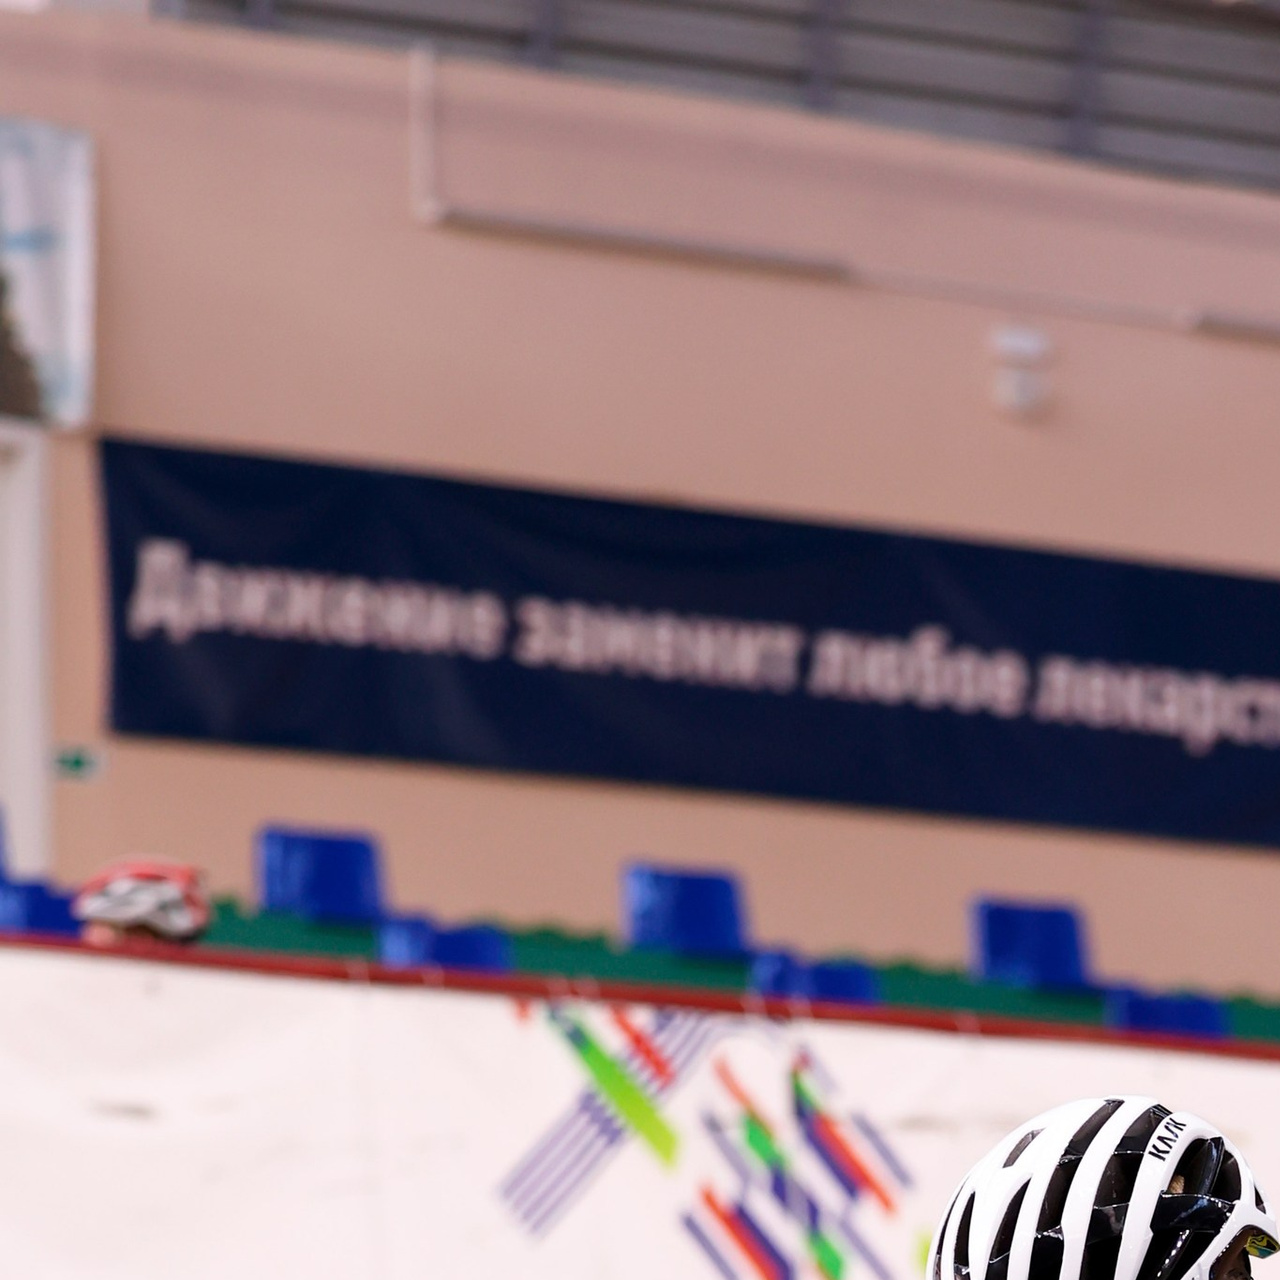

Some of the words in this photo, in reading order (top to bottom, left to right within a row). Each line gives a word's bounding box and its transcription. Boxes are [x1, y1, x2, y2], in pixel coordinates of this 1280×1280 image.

[128, 540, 507, 660] Движение
[515, 596, 803, 692] заменит
[808, 626, 1030, 720] любое
[1148, 1117, 1187, 1162] KASK
